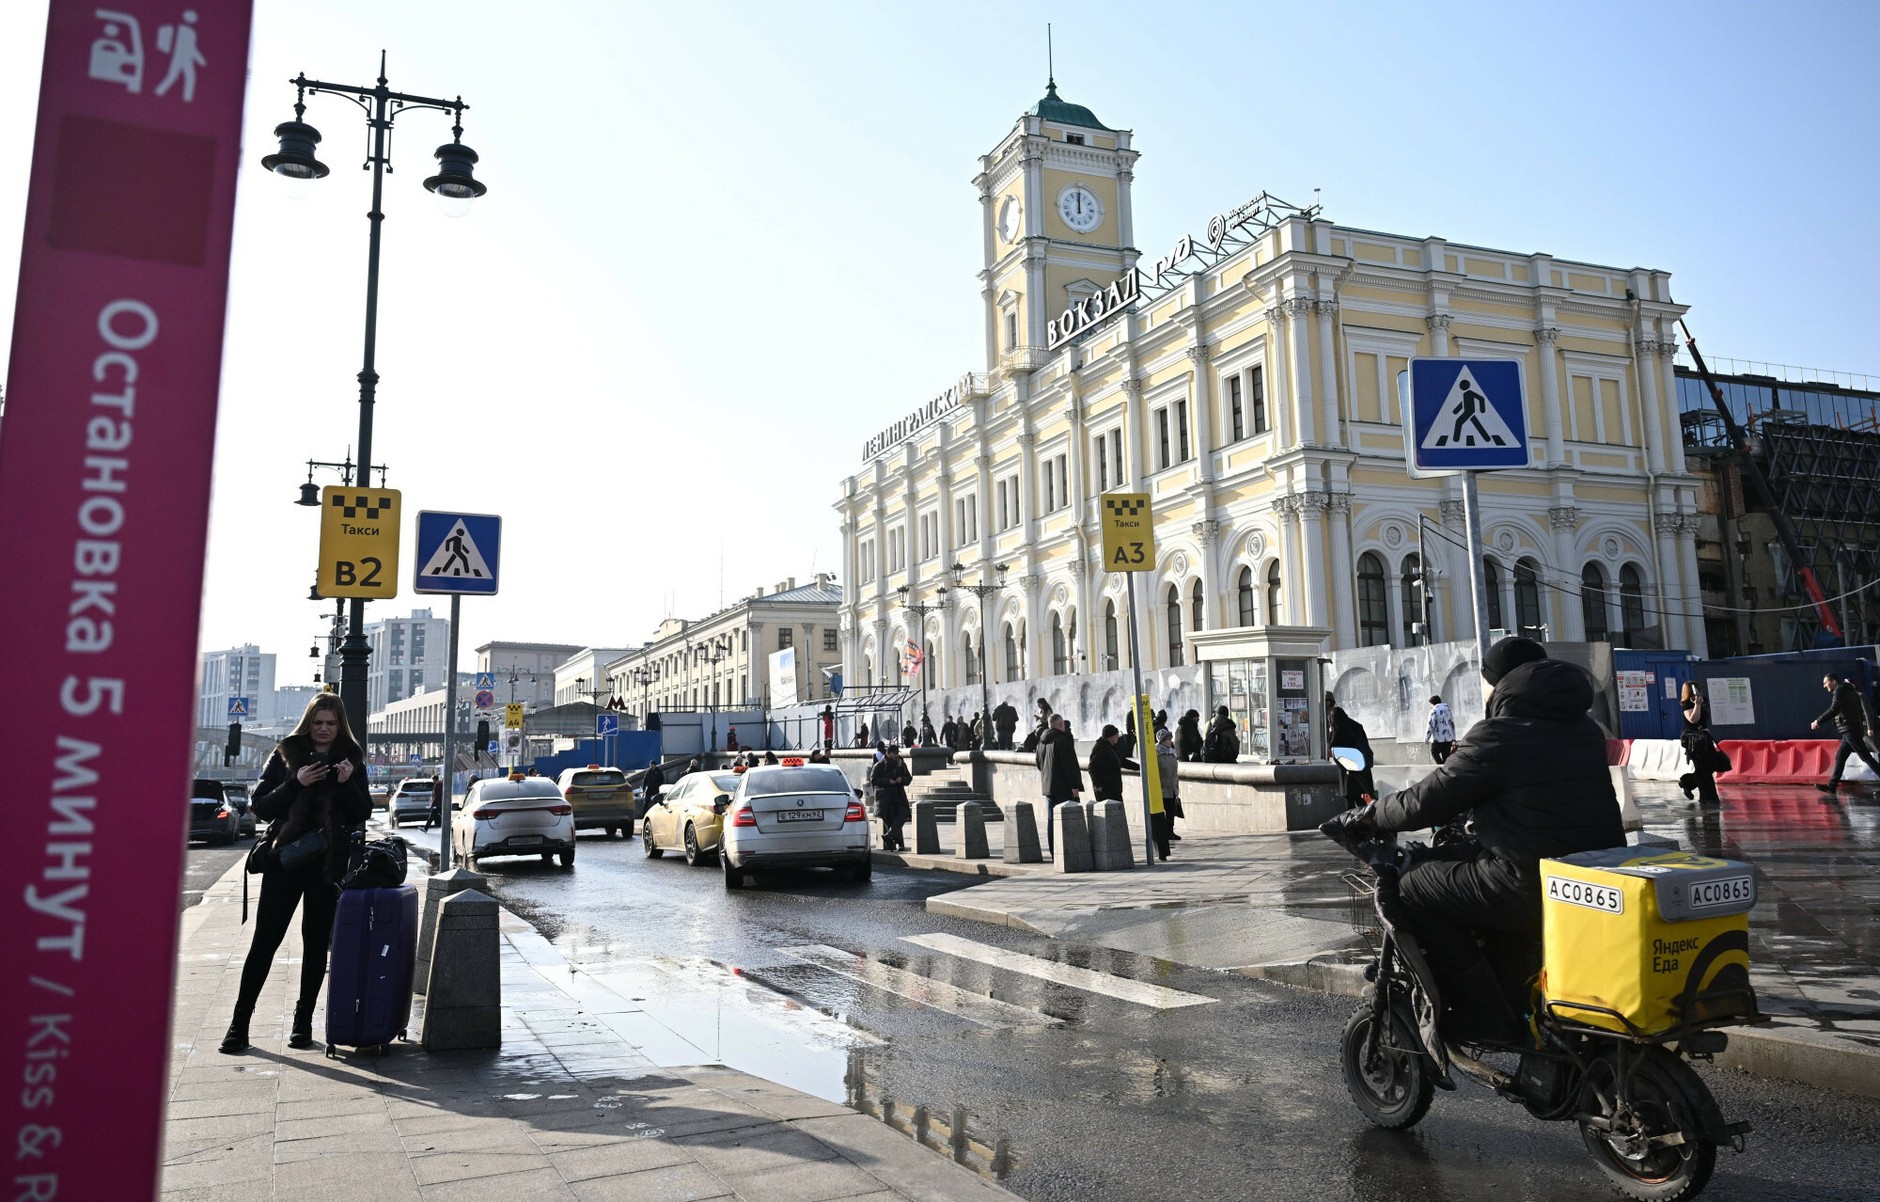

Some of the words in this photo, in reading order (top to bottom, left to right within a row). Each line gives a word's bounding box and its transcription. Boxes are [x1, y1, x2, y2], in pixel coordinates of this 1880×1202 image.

[1047, 267, 1140, 347] ВОКЗАЛ
[67, 299, 159, 652] Остановка
[341, 524, 379, 535] Такси
[1113, 543, 1145, 563] A3
[335, 556, 382, 587] B2
[60, 674, 125, 717] 5
[24, 735, 102, 960] минут
[1550, 880, 1618, 909] АС0865
[1693, 881, 1750, 905] АС0865
[1653, 937, 1699, 955] Яндекс
[1653, 956, 1679, 974] Еда
[22, 1014, 72, 1107] Kiss
[17, 1124, 62, 1160] &
